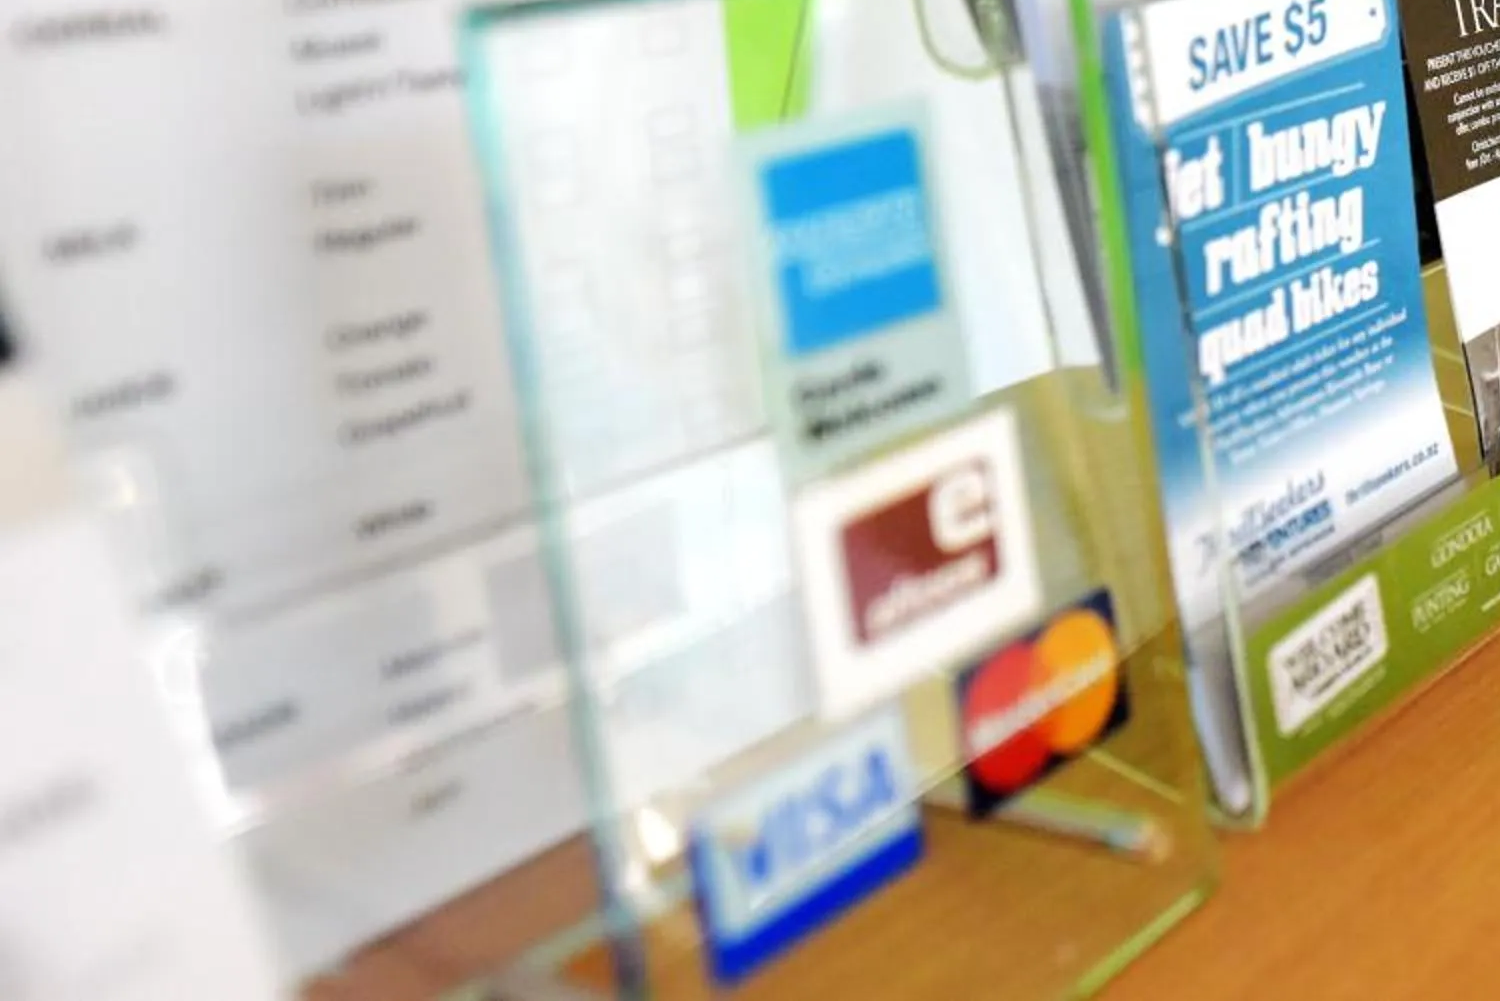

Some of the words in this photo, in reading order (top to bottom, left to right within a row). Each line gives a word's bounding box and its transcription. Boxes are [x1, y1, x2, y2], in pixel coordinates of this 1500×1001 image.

[1187, 11, 1276, 92] SAVE
[1248, 101, 1387, 193] bungy
[1203, 186, 1365, 297] rafting
[1200, 286, 1290, 386] quad
[1289, 259, 1380, 333] bikes
